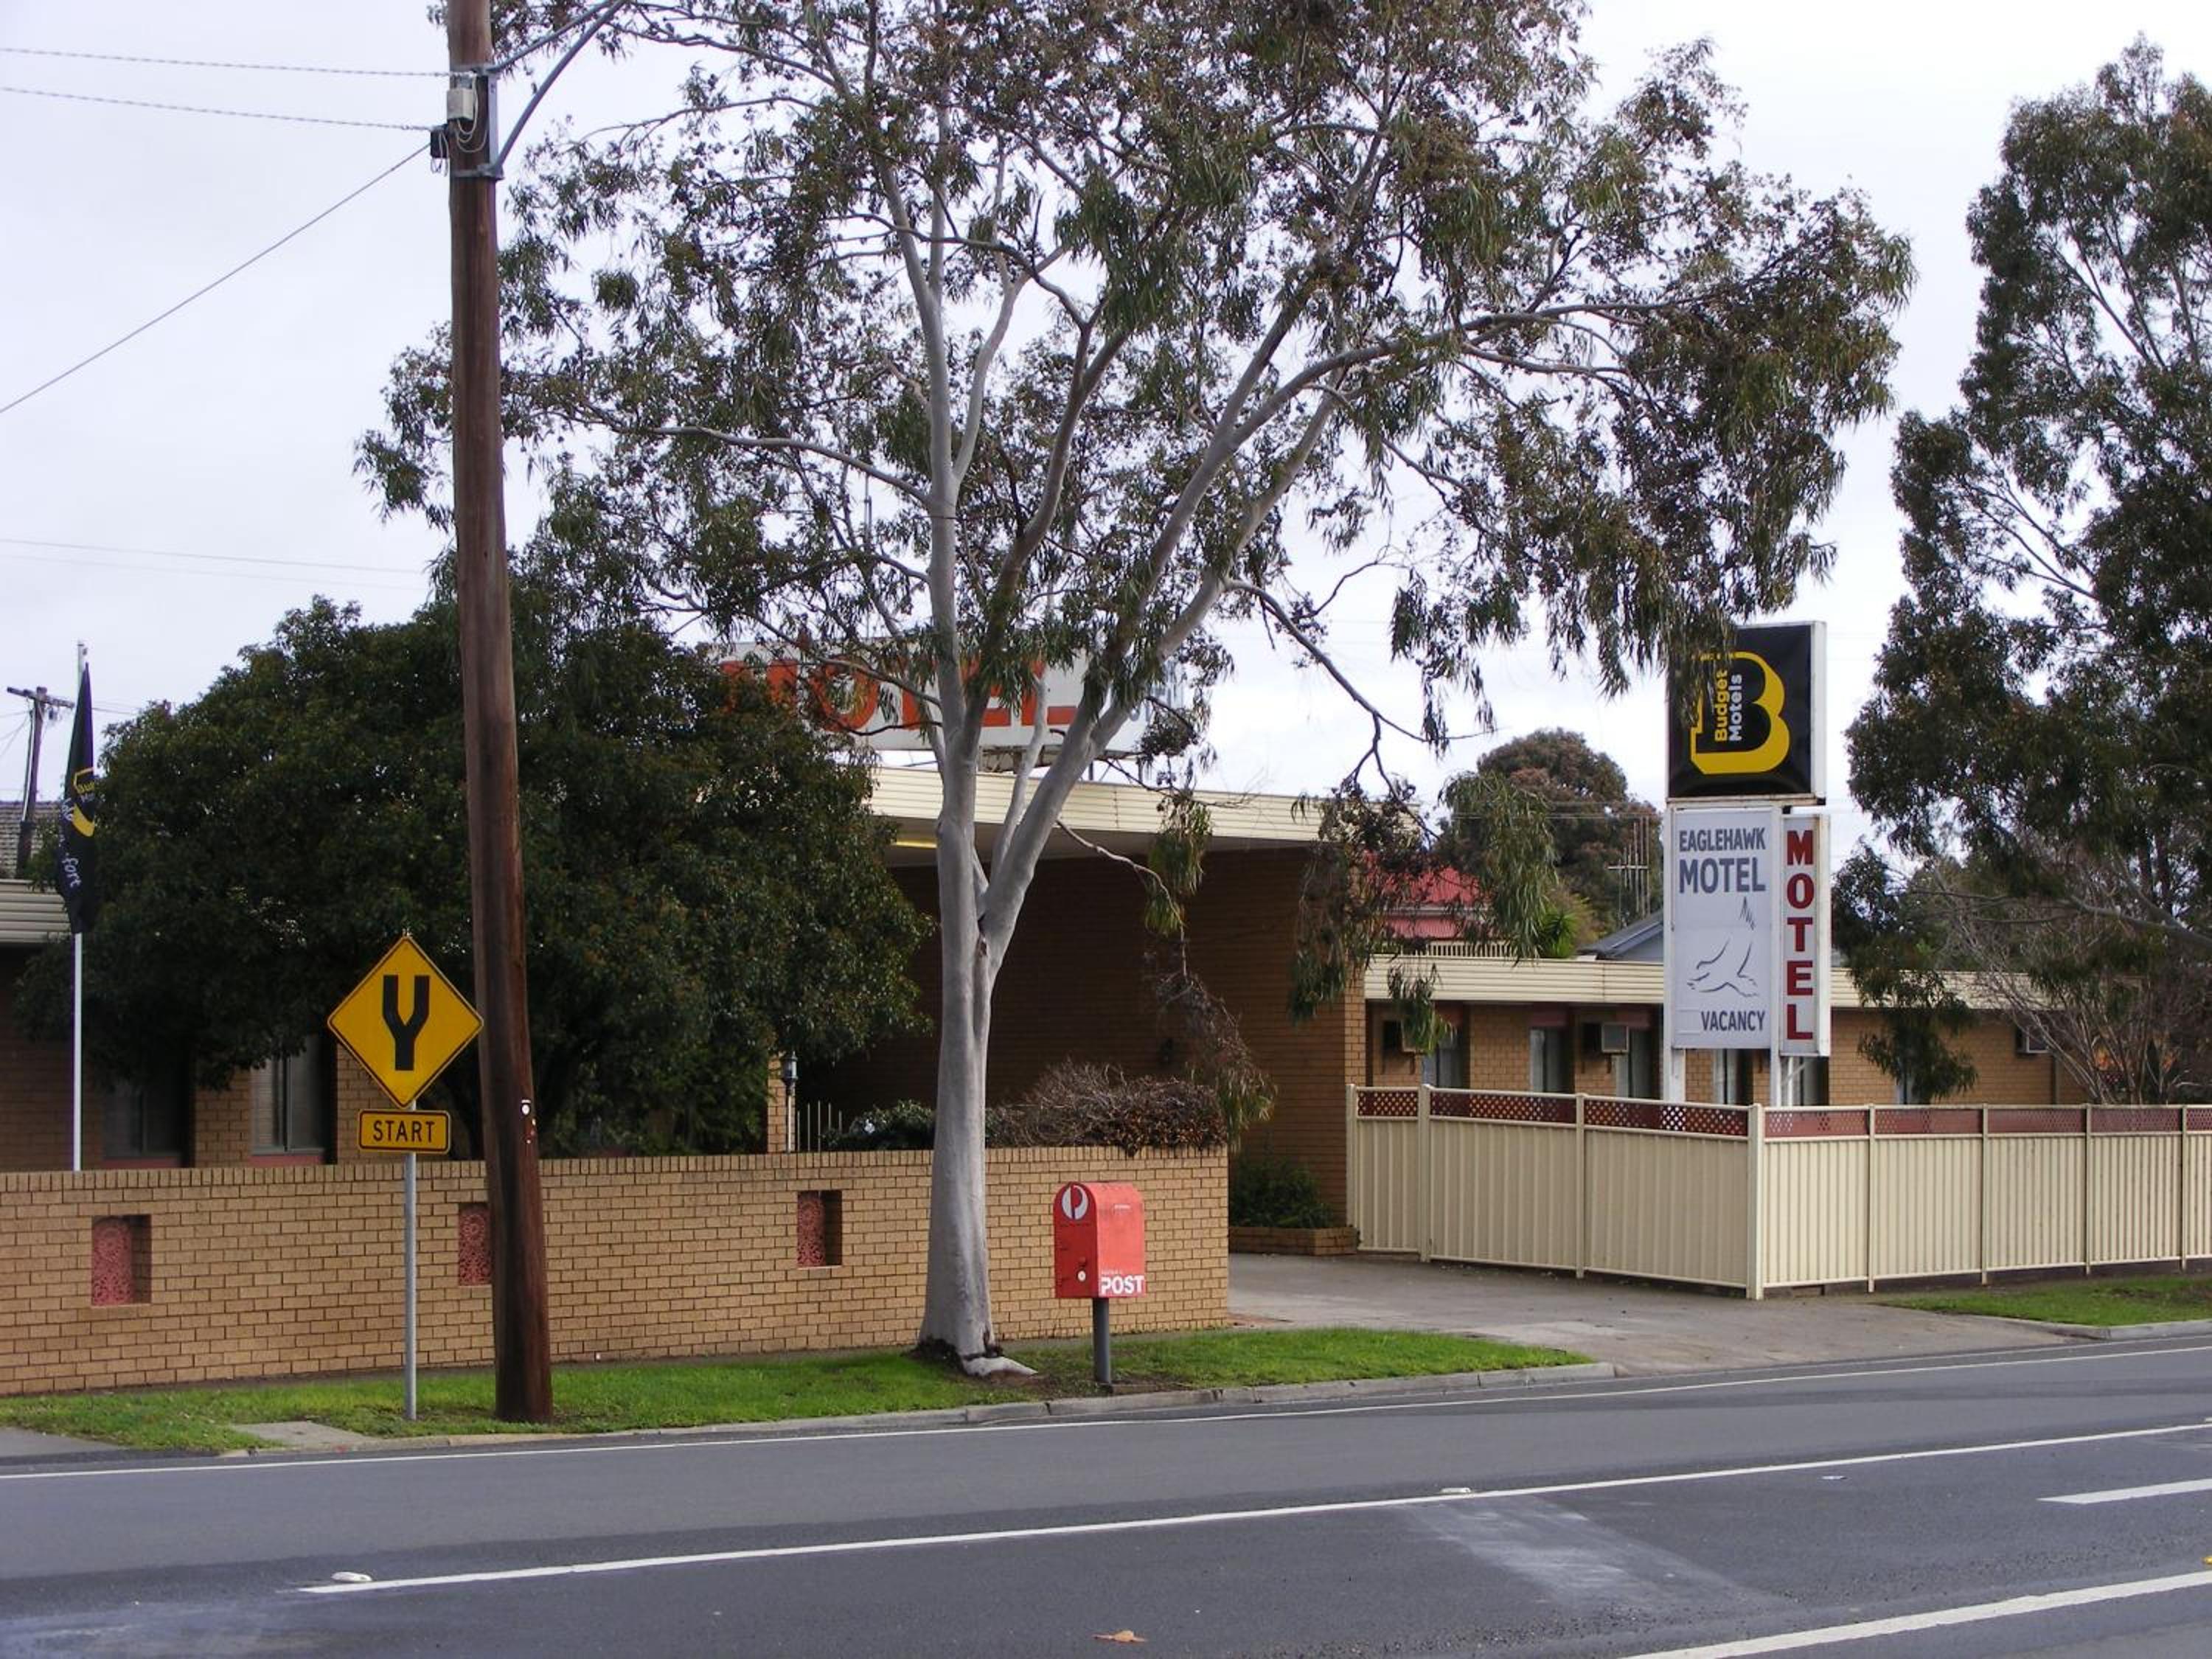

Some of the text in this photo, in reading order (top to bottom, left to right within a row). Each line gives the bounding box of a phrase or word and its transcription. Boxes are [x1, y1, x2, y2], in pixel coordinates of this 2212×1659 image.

[1714, 669, 1731, 742] Budget
[1728, 674, 1742, 742] Motels
[1679, 827, 1766, 852] EAGLEHAWK
[1679, 857, 1766, 894] MOTEL
[1787, 830, 1815, 1040] MOTEL
[1701, 1010, 1765, 1032] VACANCY
[373, 1119, 435, 1142] START
[1100, 1275, 1145, 1295] POST
